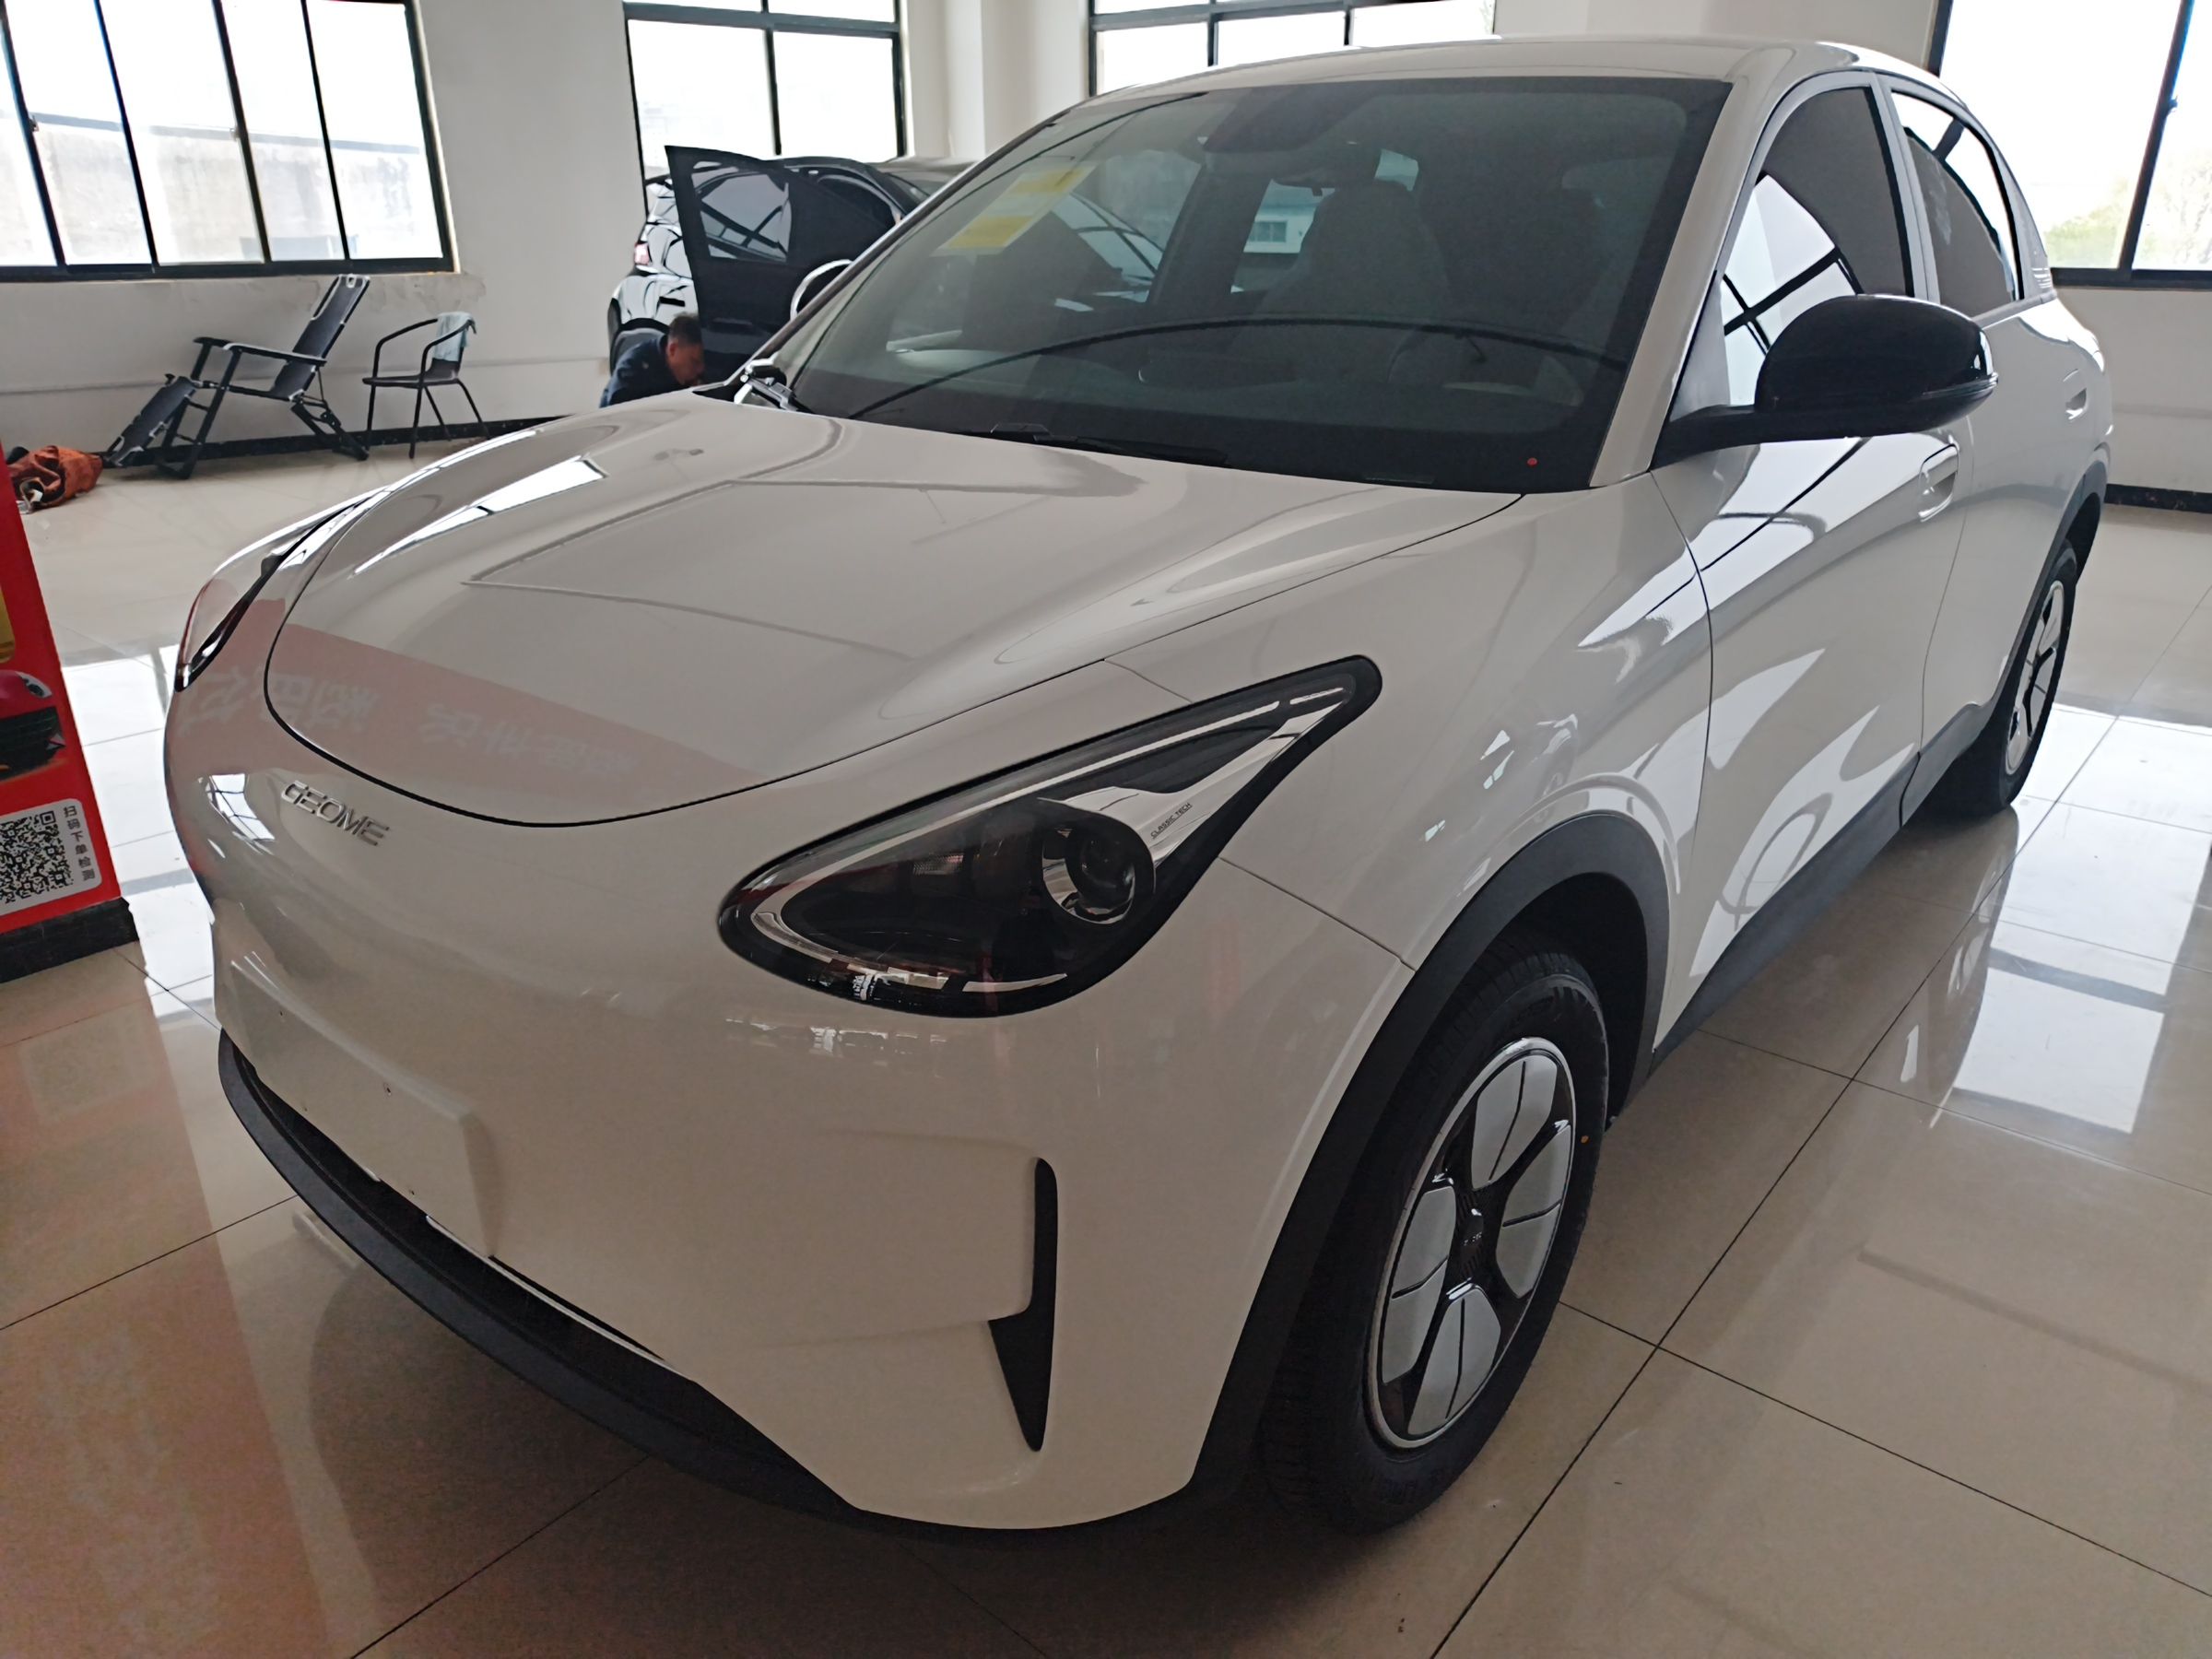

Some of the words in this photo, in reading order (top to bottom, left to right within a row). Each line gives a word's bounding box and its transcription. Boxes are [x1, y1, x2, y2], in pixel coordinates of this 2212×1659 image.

[281, 780, 390, 846] GEOME
[1150, 815, 1176, 839] CLASSIC
[1174, 802, 1193, 817] TECH
